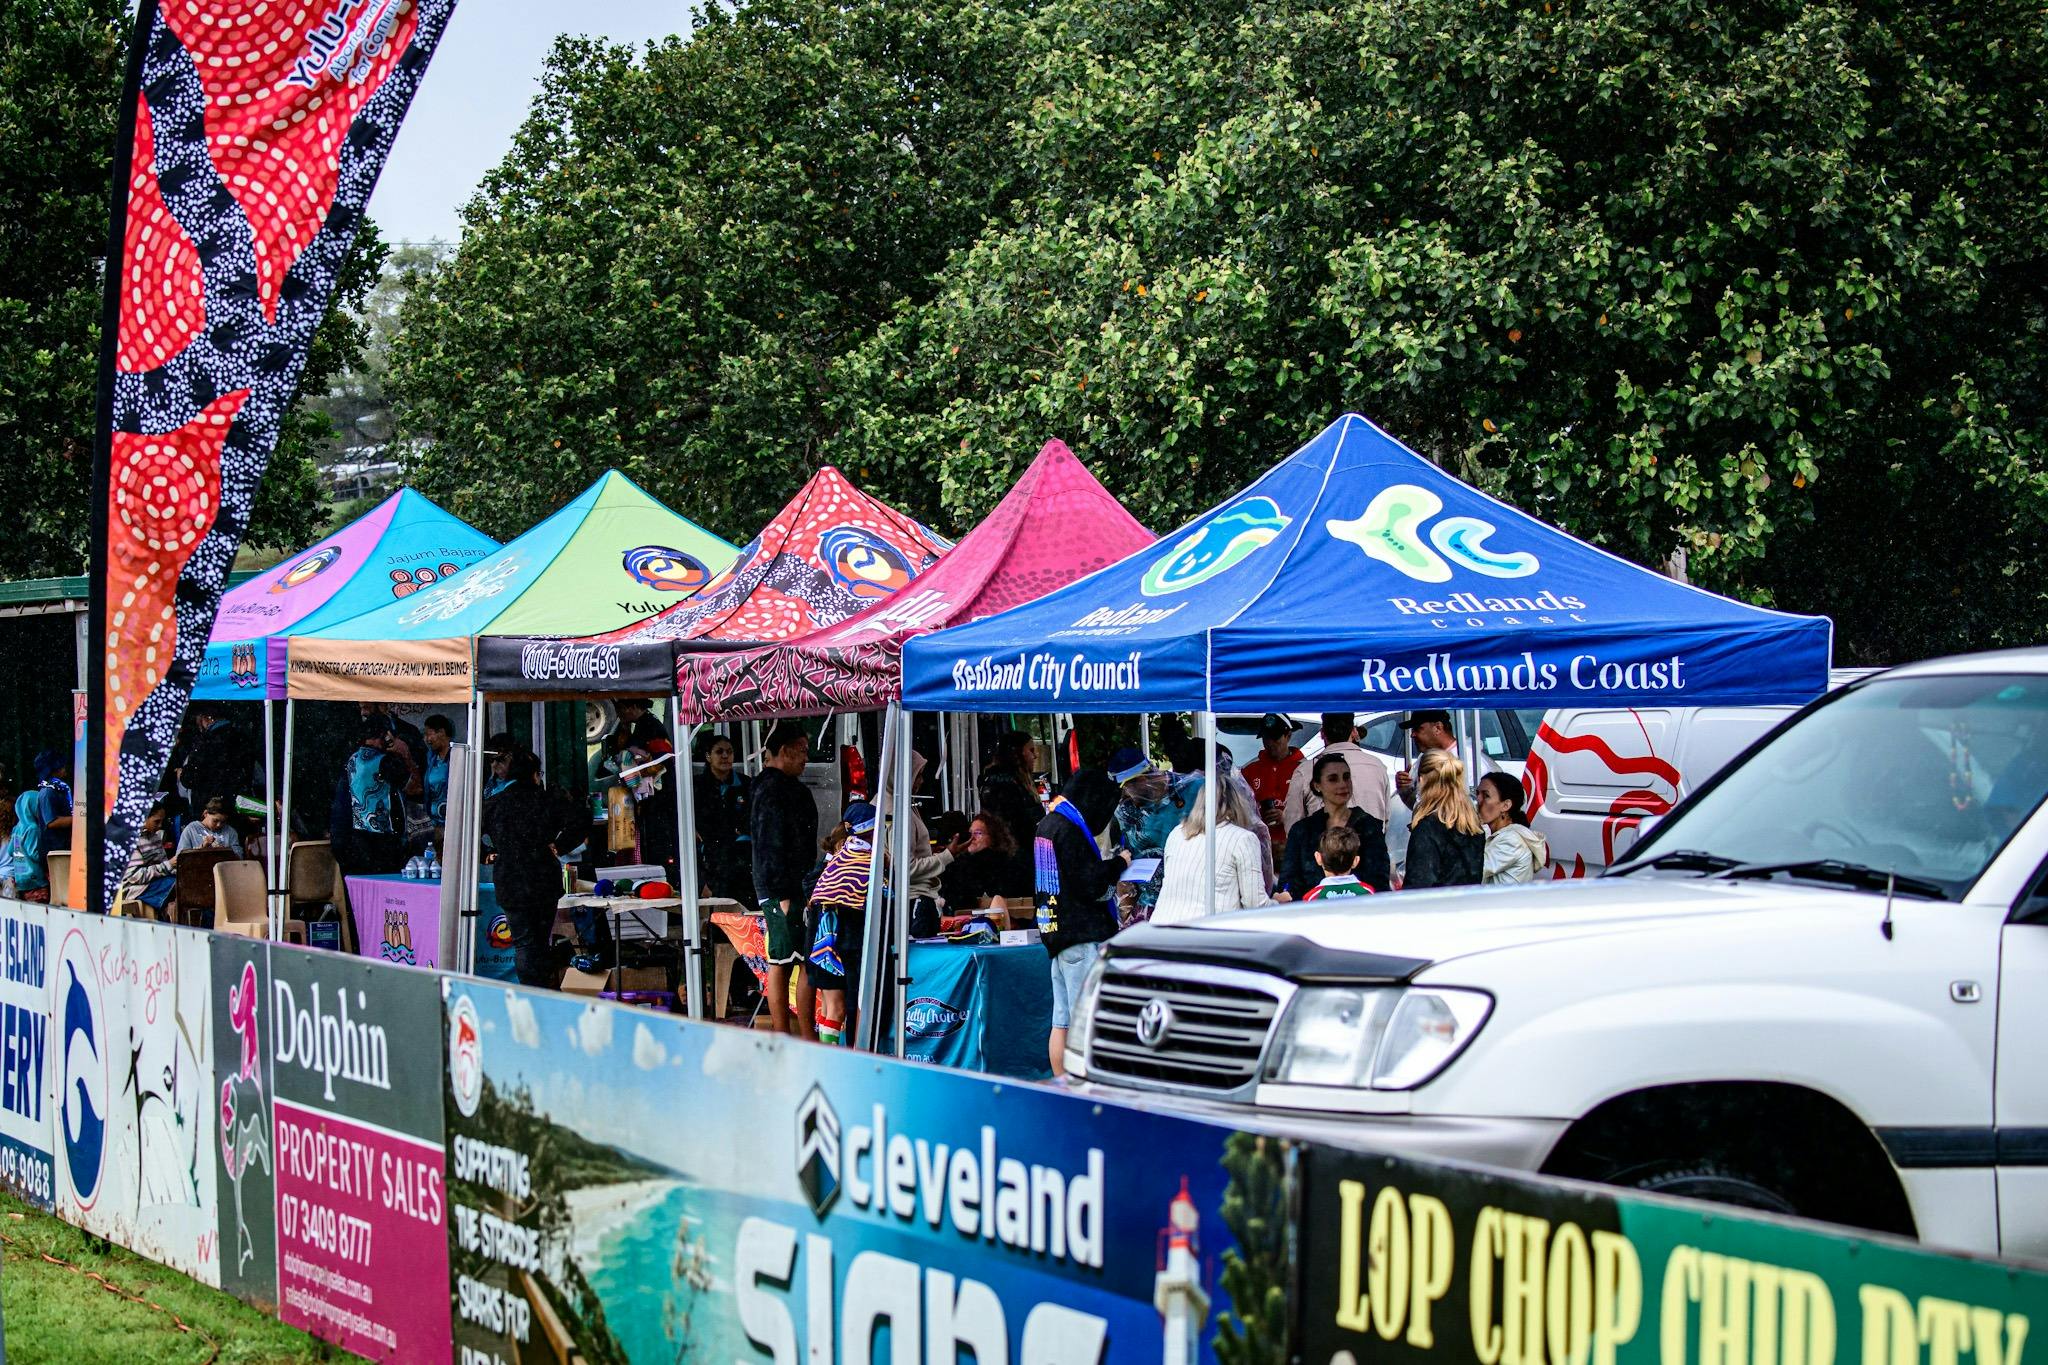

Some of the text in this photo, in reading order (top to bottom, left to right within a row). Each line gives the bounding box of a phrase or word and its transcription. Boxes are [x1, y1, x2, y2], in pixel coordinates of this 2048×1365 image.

[351, 57, 370, 82] for
[1070, 602, 1189, 628] Redland
[1386, 590, 1588, 616] Redlands
[1431, 613, 1588, 629] coast
[290, 659, 314, 674] KINSHIP
[319, 661, 341, 675] FOSTER
[340, 662, 360, 676] CARE
[359, 662, 395, 676] PROGRAM
[394, 662, 401, 676] &
[400, 662, 426, 677] FAMILY
[426, 661, 468, 676] WELLBEING
[951, 651, 1142, 700] Redland City Council
[1361, 651, 1687, 693] Redlands Coast
[5, 917, 47, 990] ISLAND
[145, 938, 175, 1025] goal
[2, 1003, 47, 1123] ERY
[273, 978, 391, 1101] Dolphin
[19, 1152, 50, 1201] 9088
[278, 1119, 442, 1226] PROPERTY SALES
[454, 1133, 531, 1199] SUPPORTING
[845, 1102, 1106, 1269] cleveland
[281, 1192, 372, 1267] 07 3409 8777
[454, 1203, 481, 1253] THE
[1336, 1178, 1455, 1350] LOP
